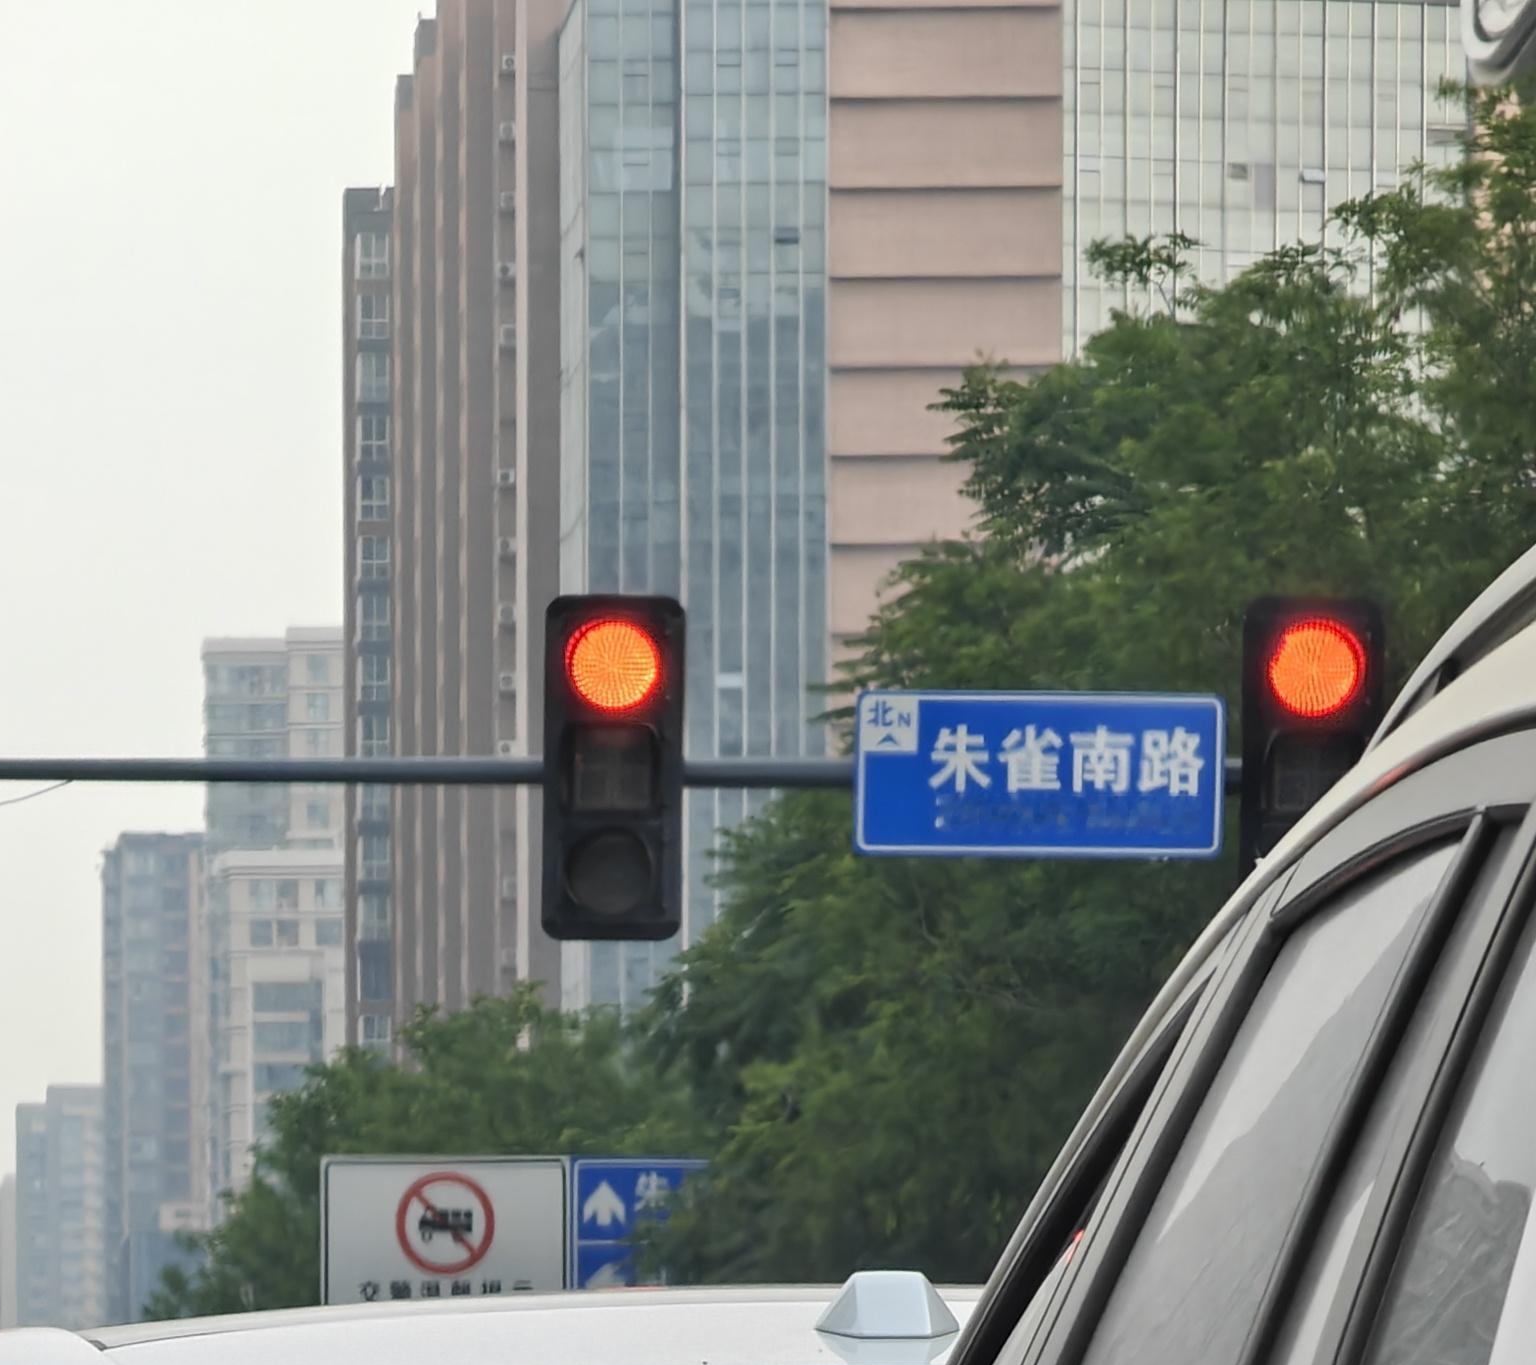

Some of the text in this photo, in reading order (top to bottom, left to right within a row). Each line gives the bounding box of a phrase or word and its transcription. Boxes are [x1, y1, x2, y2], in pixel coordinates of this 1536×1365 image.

[867, 700, 911, 728] 北 N
[928, 724, 1204, 797] 朱雀南路
